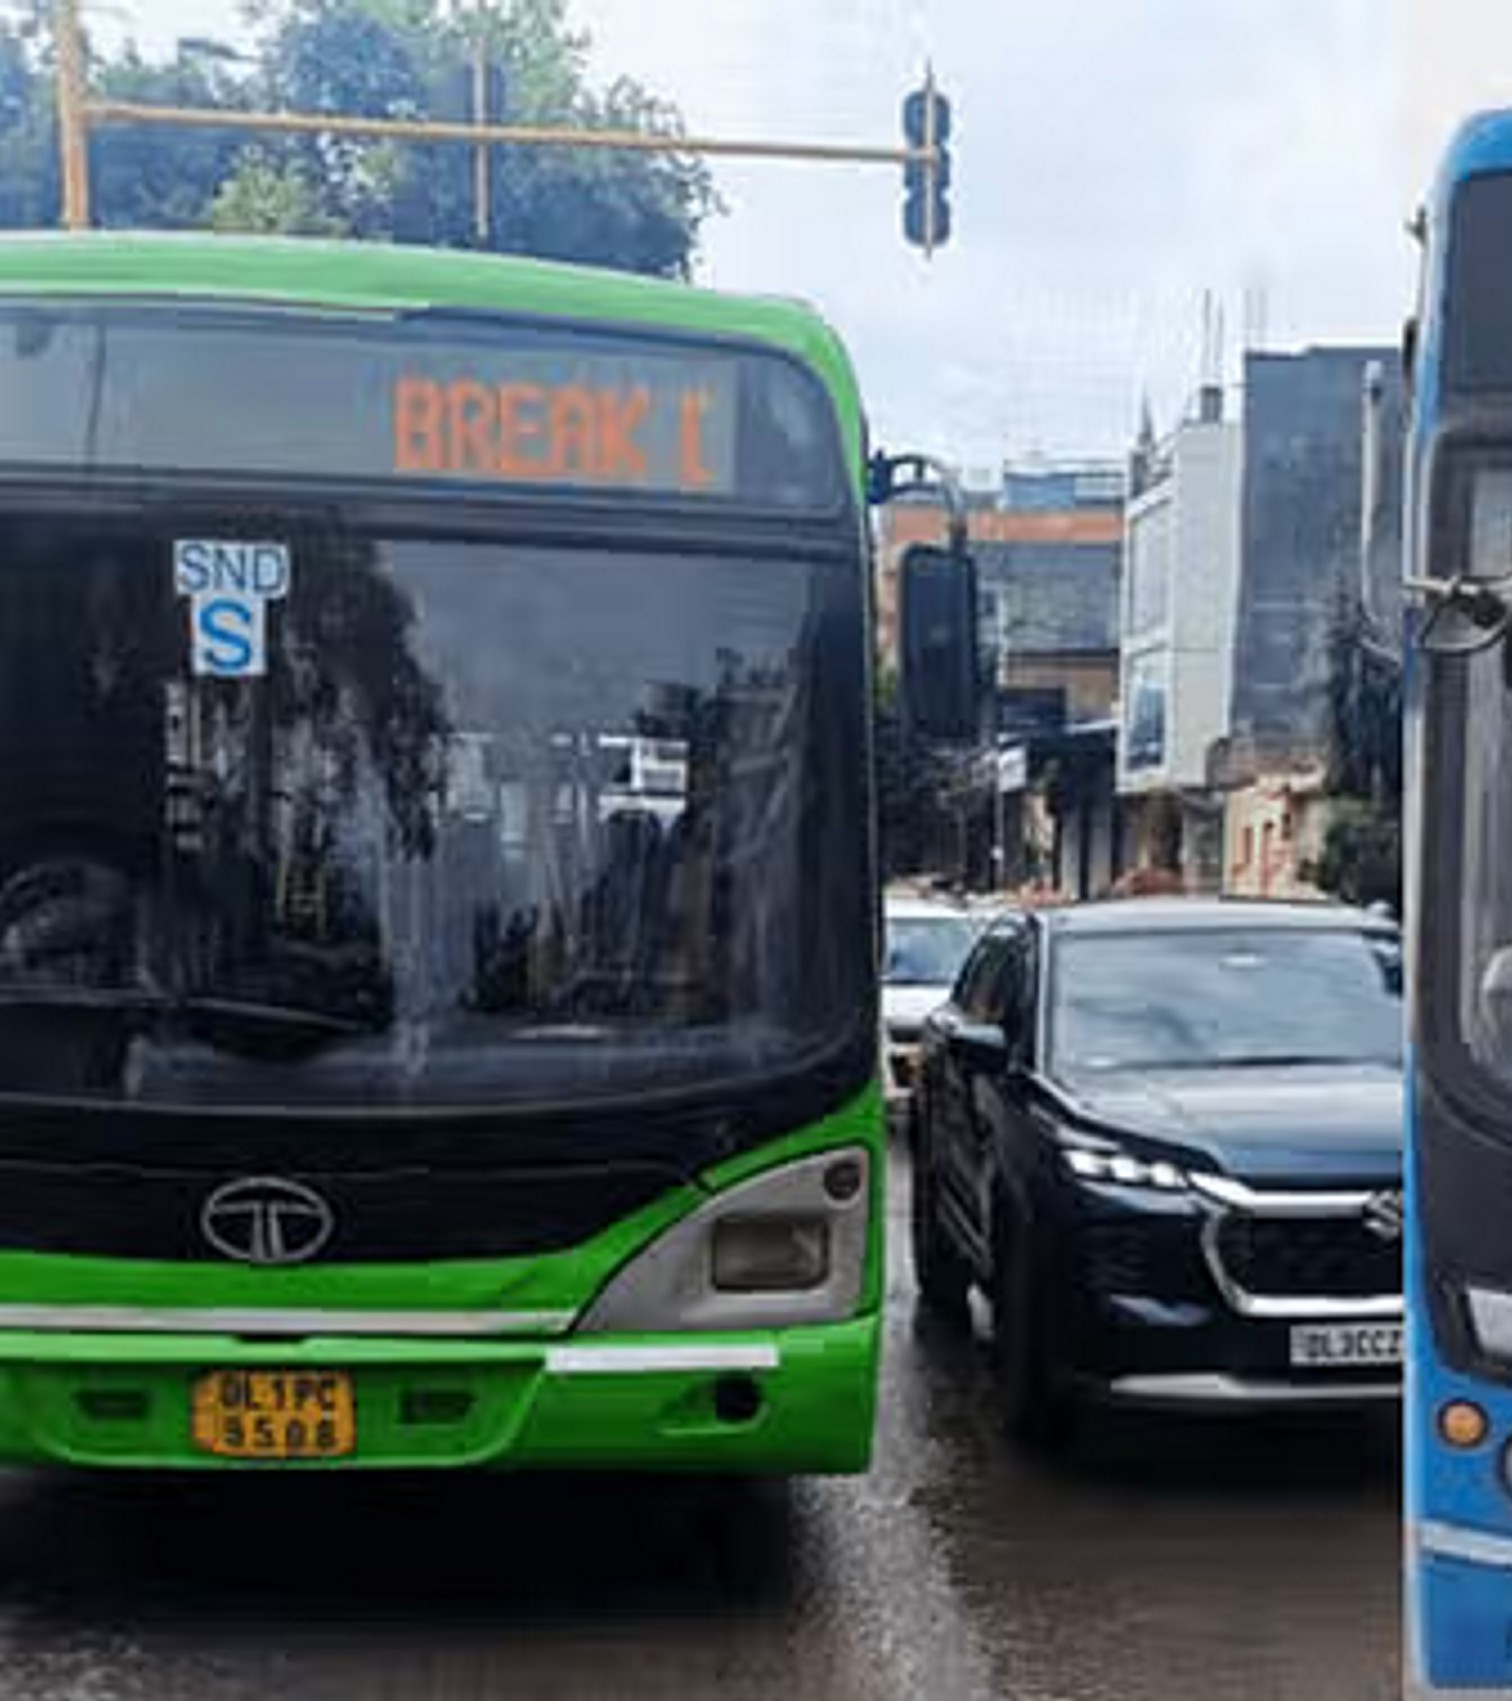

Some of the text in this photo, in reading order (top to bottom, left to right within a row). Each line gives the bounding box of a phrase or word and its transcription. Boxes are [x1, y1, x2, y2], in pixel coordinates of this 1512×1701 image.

[394, 375, 648, 482] BREAK
[178, 542, 286, 593] SND
[199, 598, 252, 674] S
